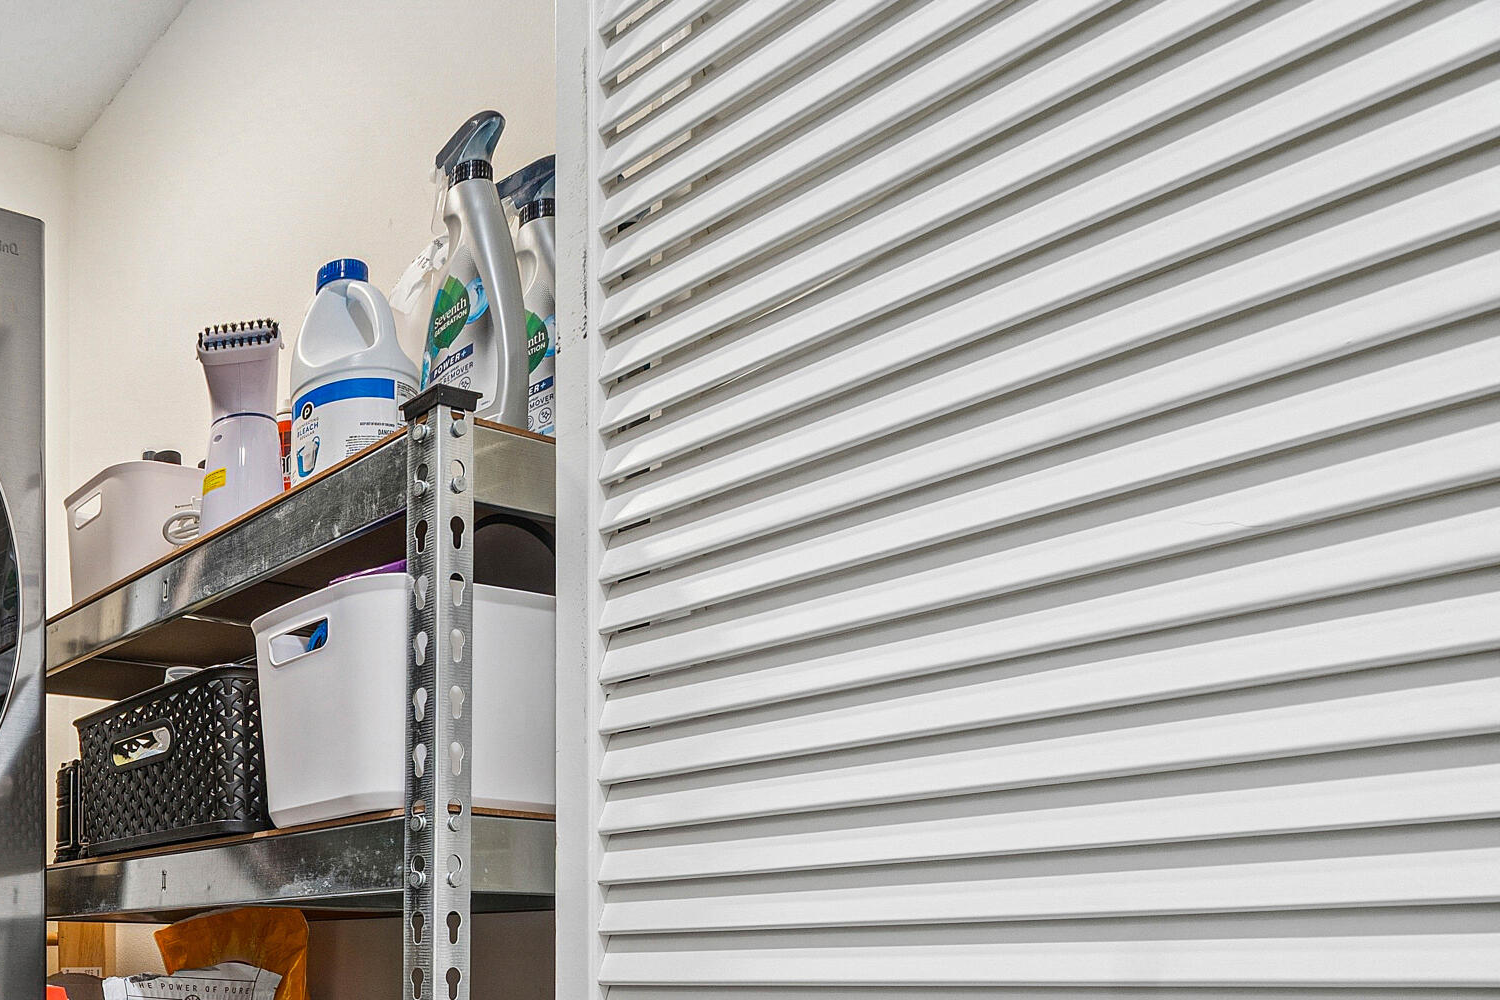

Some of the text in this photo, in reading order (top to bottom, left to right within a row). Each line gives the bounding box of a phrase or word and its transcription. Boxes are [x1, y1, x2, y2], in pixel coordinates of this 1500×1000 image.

[434, 297, 467, 330] Seventh
[434, 308, 468, 338] GENERATION
[297, 421, 319, 438] BLEACH
[161, 983, 198, 992] POWER
[205, 985, 217, 993] OF
[224, 986, 250, 995] PURE
